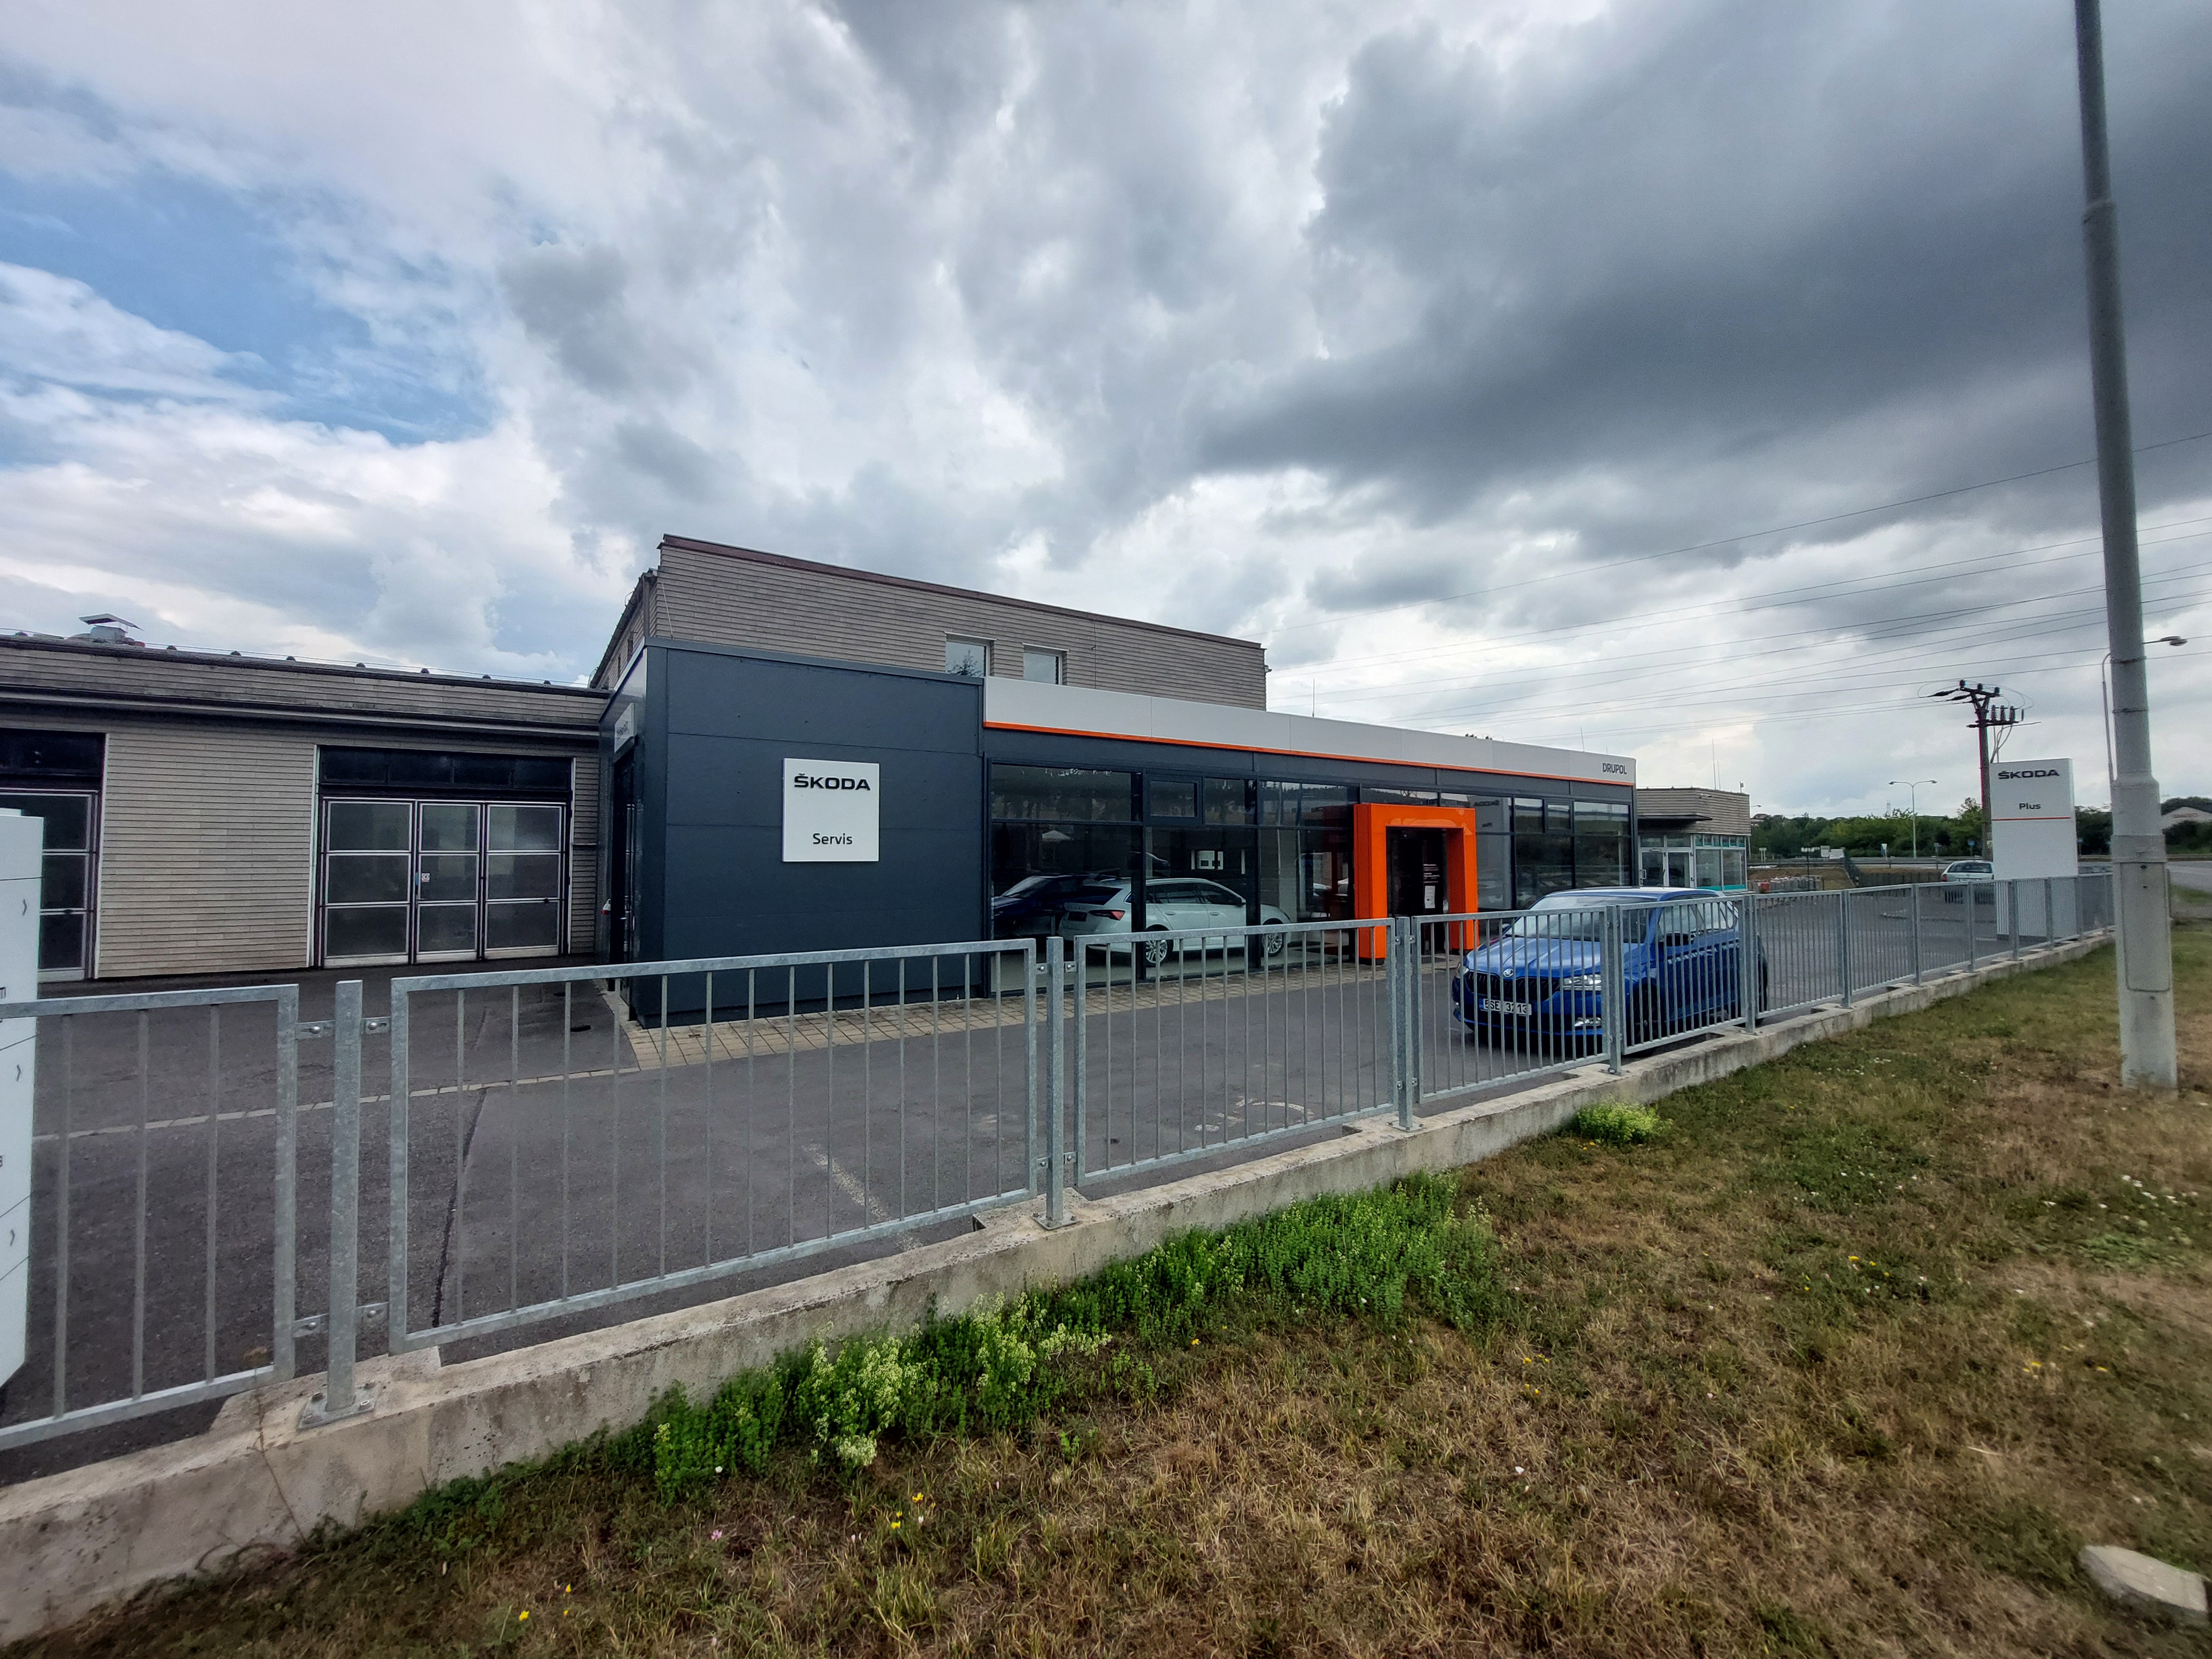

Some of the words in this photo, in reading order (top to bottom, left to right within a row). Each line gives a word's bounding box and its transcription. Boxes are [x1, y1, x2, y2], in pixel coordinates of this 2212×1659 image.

[1602, 763, 1627, 775] DRUPOL
[1998, 769, 2060, 780] ŠKODA
[794, 773, 871, 791] ŠKODA
[812, 833, 853, 845] Servis
